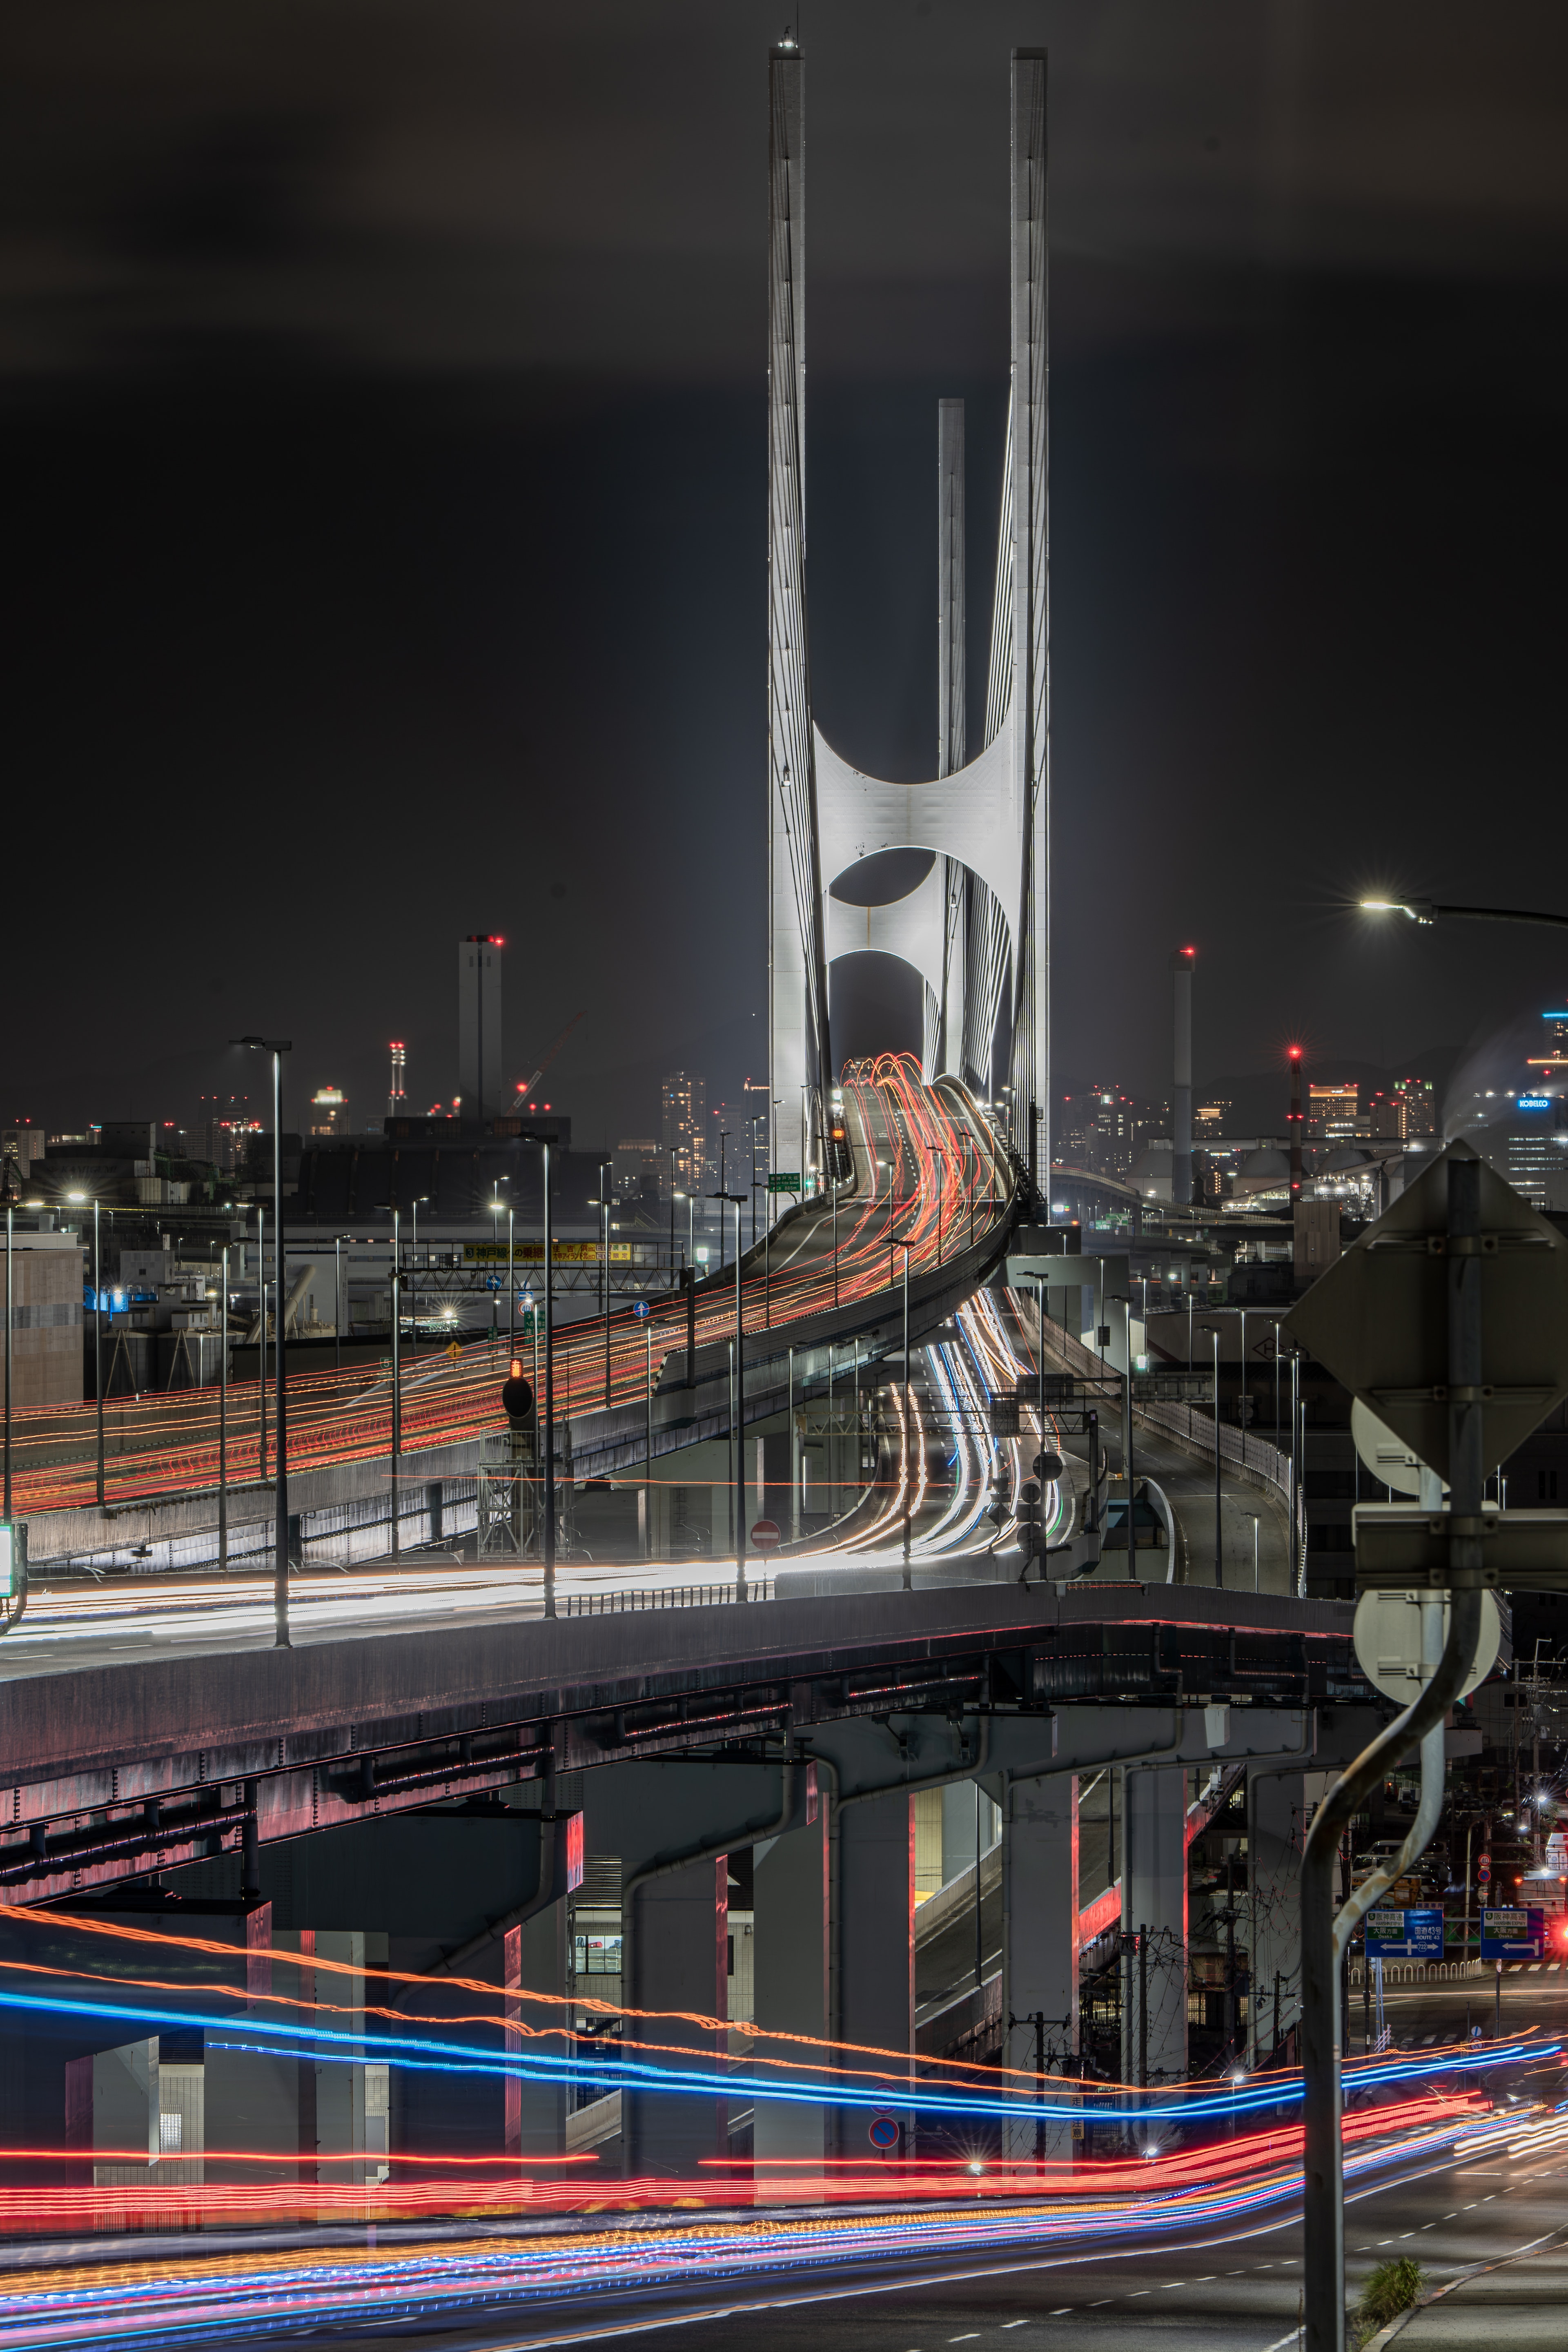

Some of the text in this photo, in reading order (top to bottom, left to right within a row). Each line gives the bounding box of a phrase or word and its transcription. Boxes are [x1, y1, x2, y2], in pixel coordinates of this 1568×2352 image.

[467, 1247, 546, 1259] 3 神戸線への乗継
[1264, 1343, 1275, 1354] H
[384, 1359, 390, 1368] 5
[1376, 1913, 1403, 1921] 阪神高速
[1494, 1913, 1526, 1921] 阪神高速
[1415, 1927, 1442, 1935] 国道43号
[1072, 2097, 1082, 2138] 走注意
